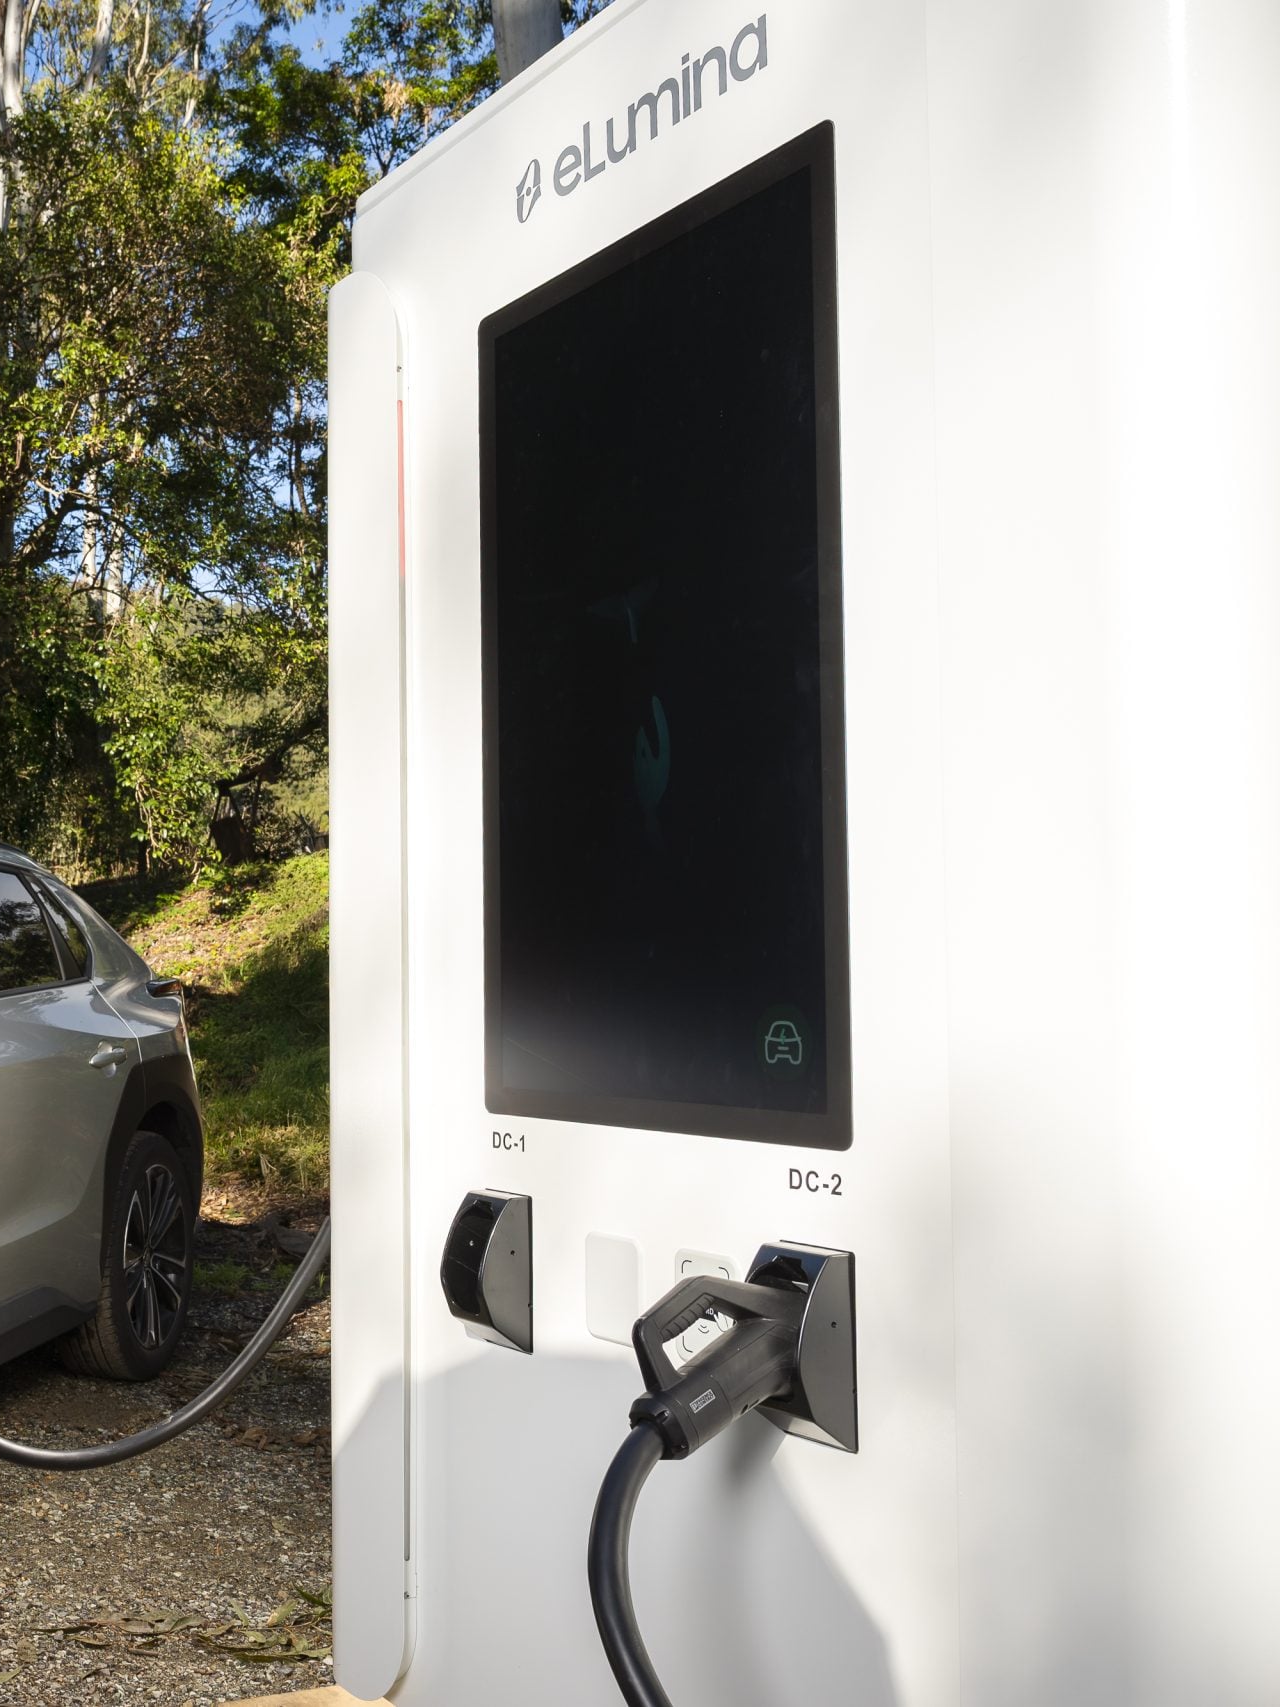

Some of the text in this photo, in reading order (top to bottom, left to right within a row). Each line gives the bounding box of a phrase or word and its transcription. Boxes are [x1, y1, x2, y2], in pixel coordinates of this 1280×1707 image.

[553, 13, 768, 197] eLumina
[492, 1131, 525, 1152] DC-1
[788, 1168, 843, 1195] DC-2
